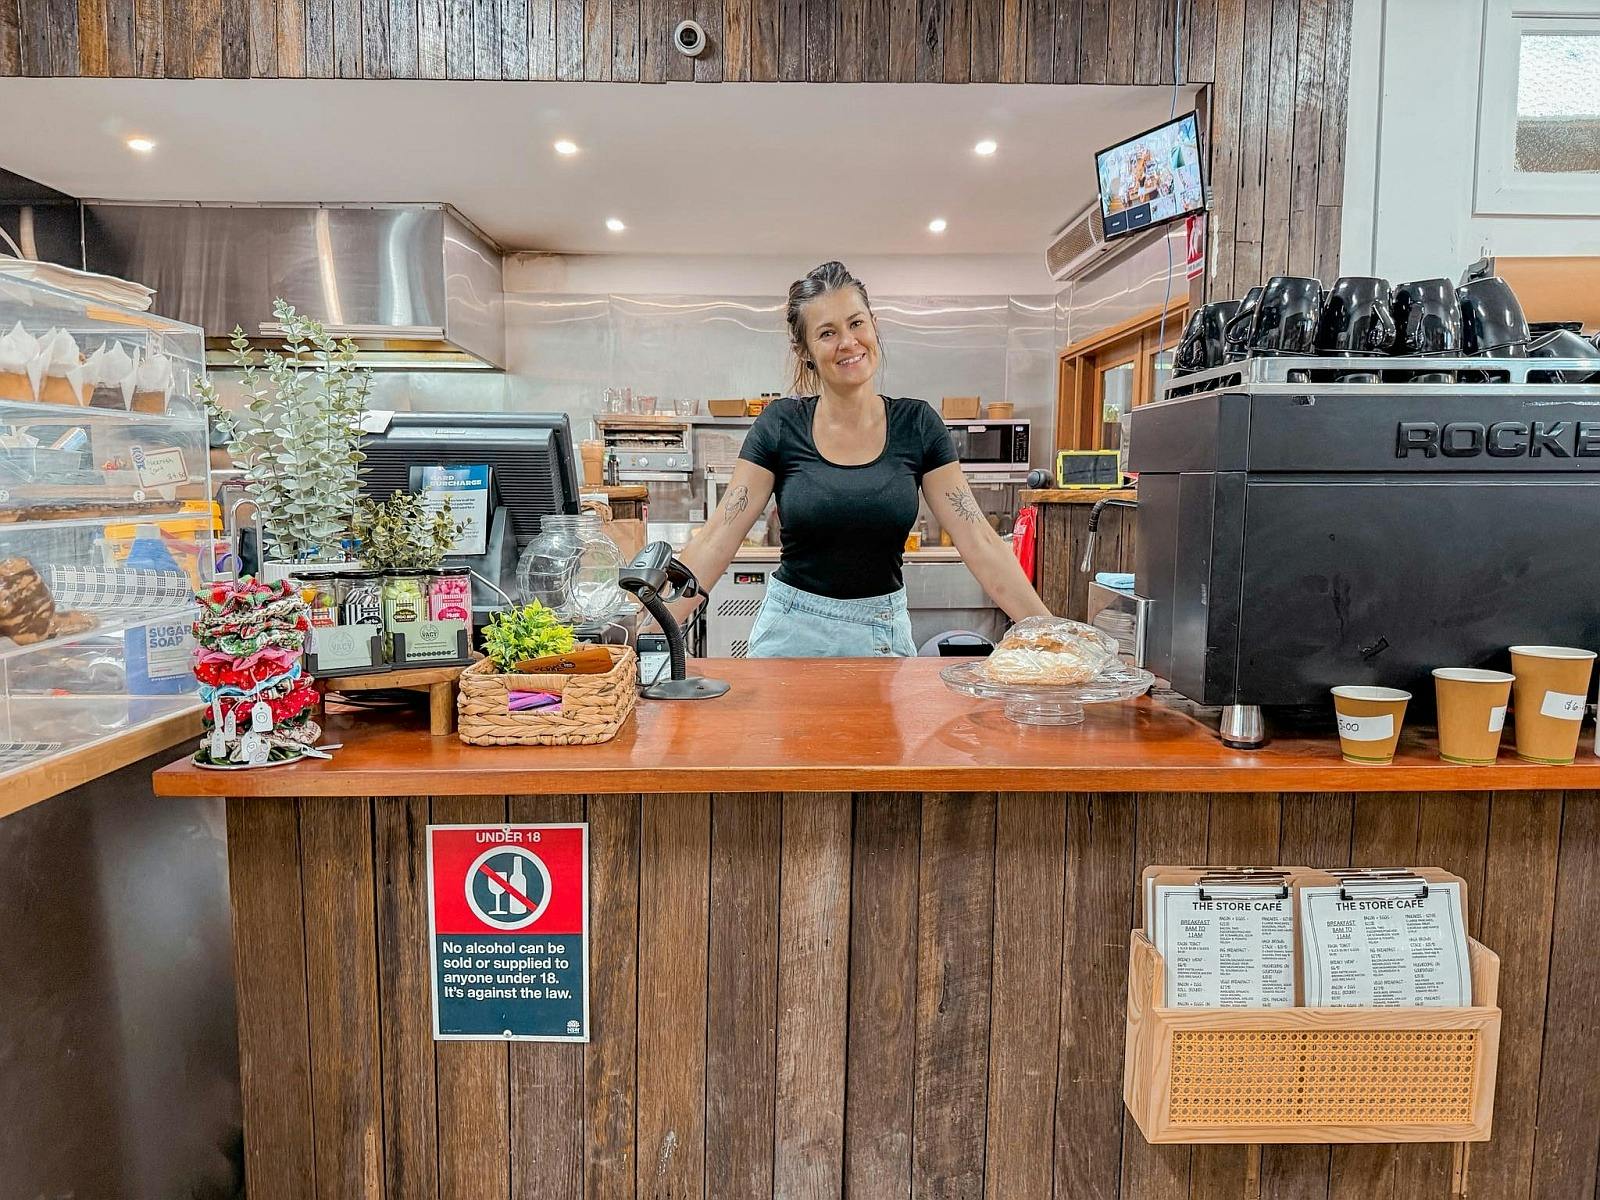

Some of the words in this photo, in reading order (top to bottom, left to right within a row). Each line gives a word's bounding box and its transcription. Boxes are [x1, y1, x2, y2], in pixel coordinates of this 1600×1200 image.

[1396, 421, 1600, 458] ROCKE
[150, 625, 192, 638] SUGAR
[150, 636, 184, 648] SOAP
[476, 832, 522, 842] UNDER
[526, 832, 541, 842] 18
[1192, 902, 1213, 911] THE
[1216, 902, 1251, 911] STORE
[1254, 900, 1282, 911] CAFÉ
[1336, 902, 1356, 911] THE
[1360, 900, 1394, 910] STORE
[443, 942, 462, 954] No
[466, 942, 515, 954] alcohol
[519, 944, 544, 954] can
[548, 942, 565, 954] be
[443, 957, 472, 968] sold
[476, 960, 489, 968] or
[493, 957, 551, 971] supplied
[555, 958, 569, 968] to
[444, 975, 493, 986] anyone
[496, 972, 536, 984] under
[540, 973, 560, 984] 18.
[444, 987, 464, 998] It's
[467, 987, 518, 1000] against
[520, 987, 543, 998] the
[545, 987, 572, 999] law.
